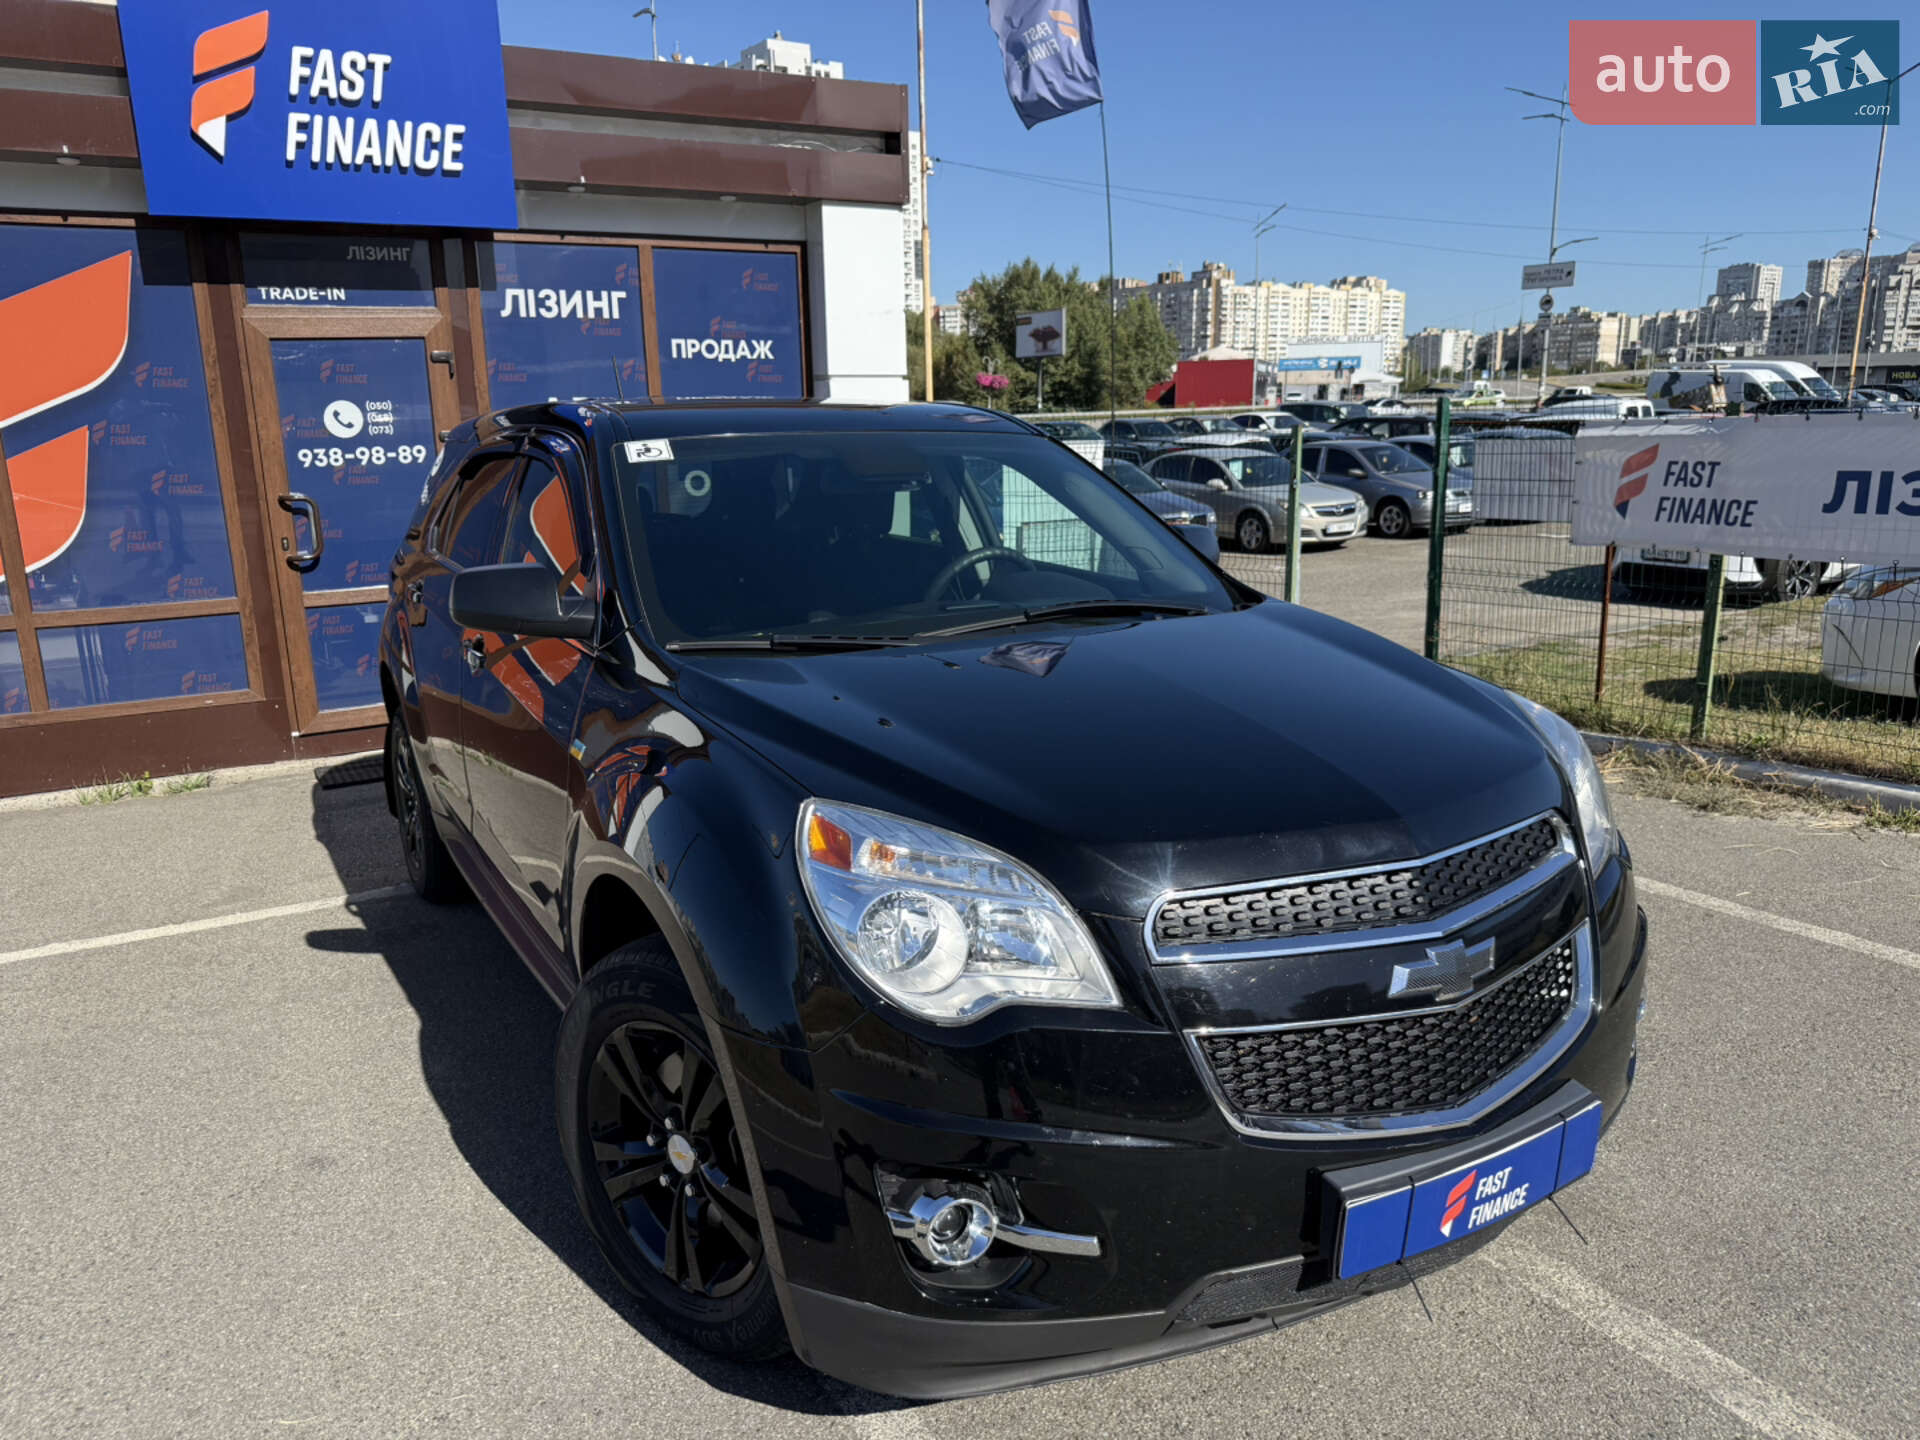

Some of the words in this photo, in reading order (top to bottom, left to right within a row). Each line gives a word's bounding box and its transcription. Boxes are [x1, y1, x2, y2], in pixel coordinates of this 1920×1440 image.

[289, 46, 391, 103] FAST
[285, 113, 466, 172] FINANCE
[347, 246, 410, 261] ЛІЗИНГ
[258, 287, 346, 300] TRADE-IN
[500, 288, 627, 320] ЛІЗИНГ
[671, 338, 775, 362] ПРОДАЖ
[369, 424, 394, 436] (073)
[297, 445, 427, 468] 938-98-89
[1663, 460, 1720, 488] FAST
[1822, 470, 1920, 515] ЛІЗ
[1655, 497, 1758, 527] FINANCE
[1475, 1166, 1513, 1200] FAST
[1468, 1183, 1530, 1229] FINANCE
